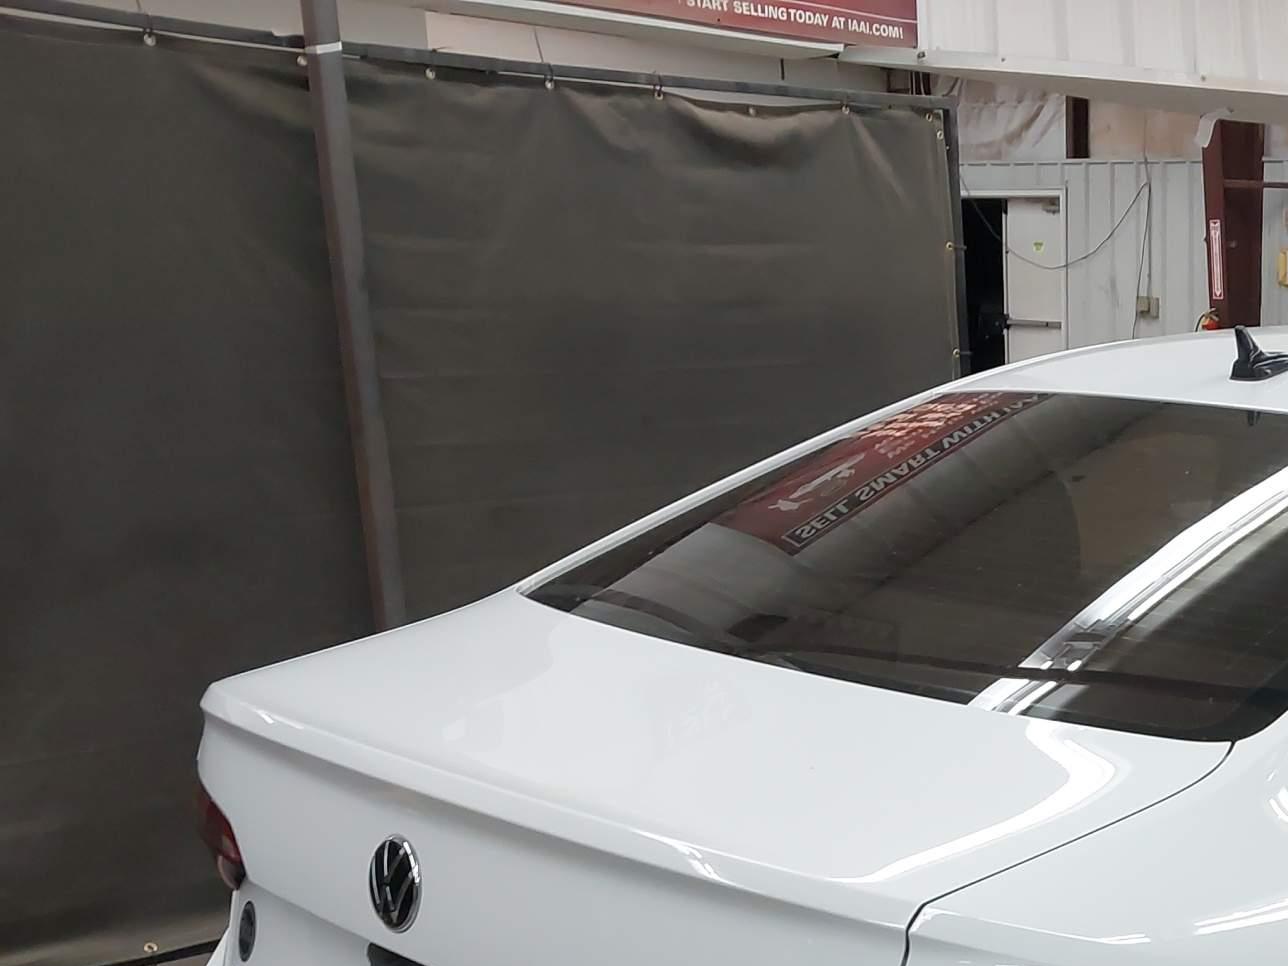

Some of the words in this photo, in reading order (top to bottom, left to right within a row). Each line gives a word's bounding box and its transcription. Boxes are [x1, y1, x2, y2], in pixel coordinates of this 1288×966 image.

[733, 2, 788, 21] SELLING
[788, 9, 829, 27] TODAY
[831, 16, 846, 30] AT
